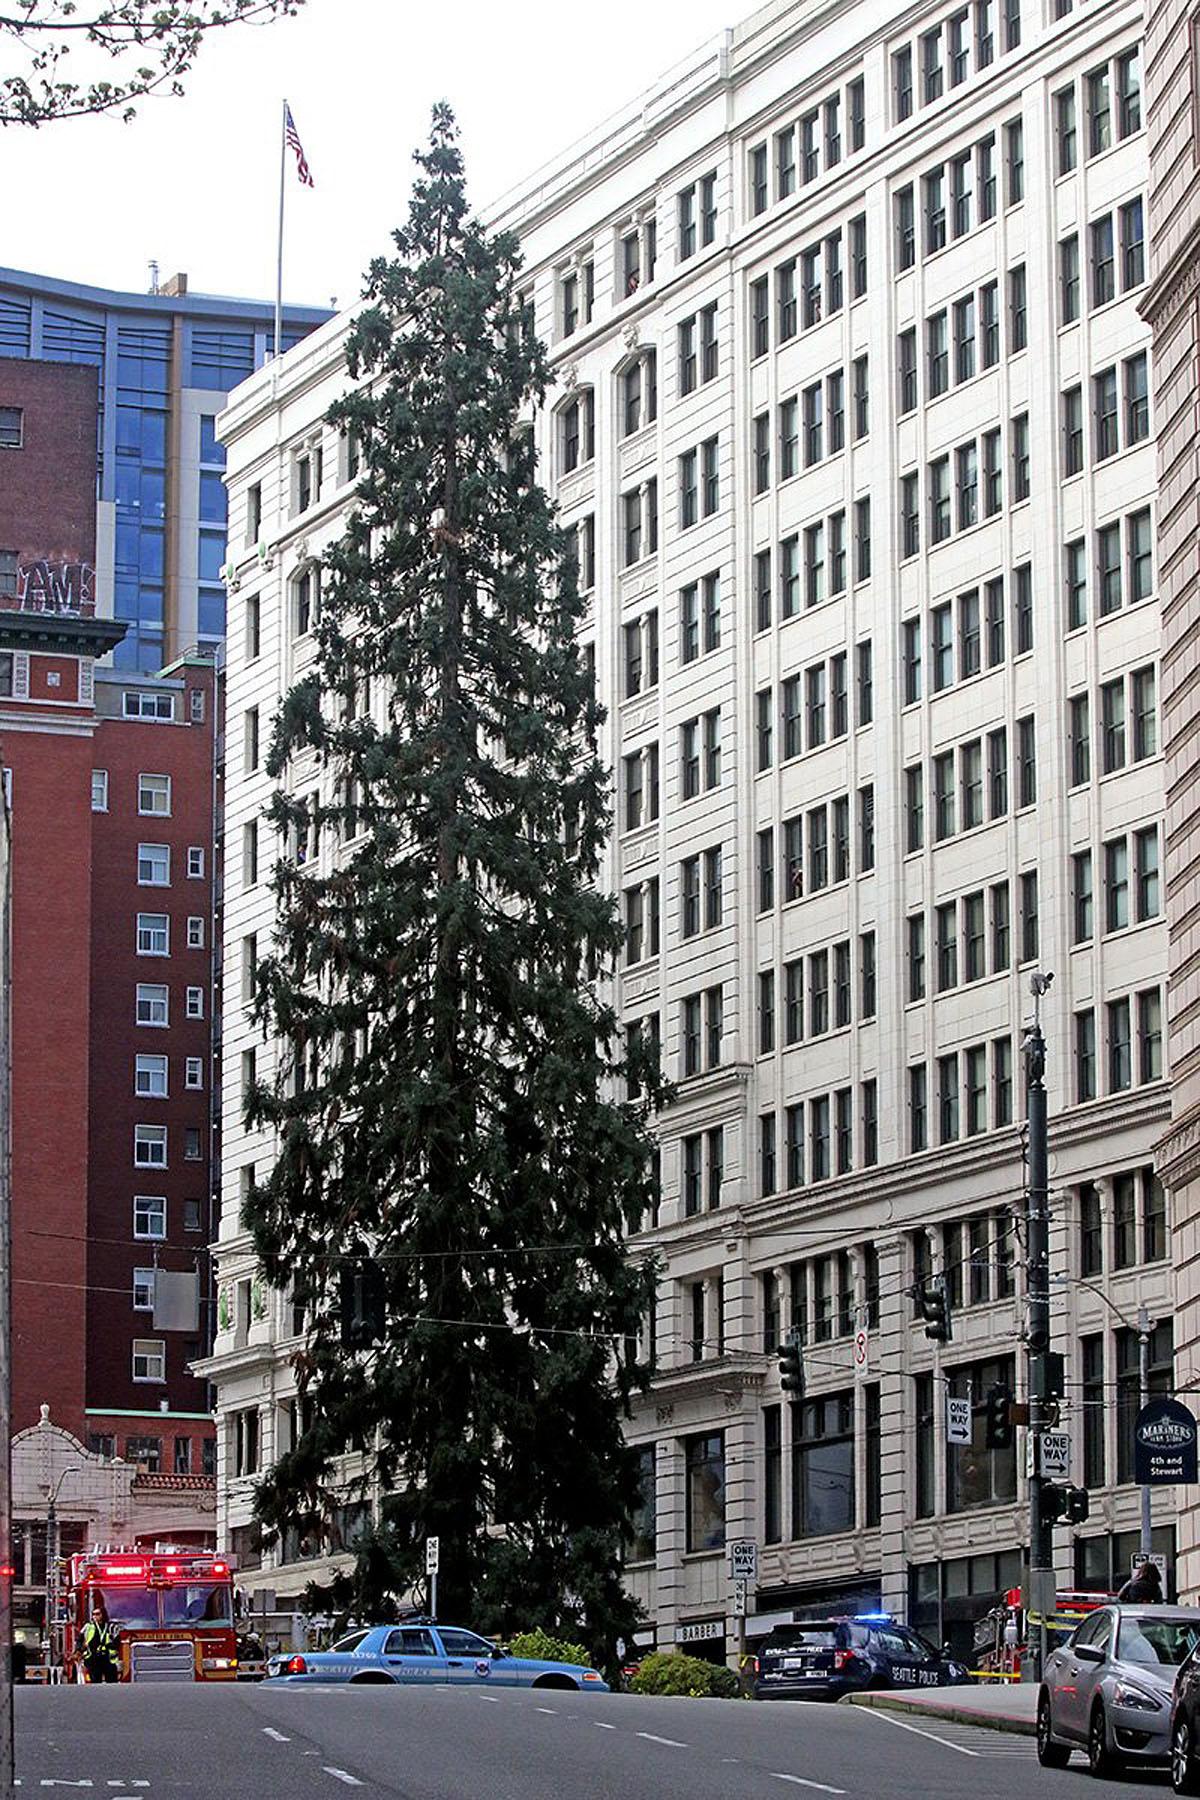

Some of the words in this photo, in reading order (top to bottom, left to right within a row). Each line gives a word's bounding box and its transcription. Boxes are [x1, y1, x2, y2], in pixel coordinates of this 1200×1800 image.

[950, 1402, 968, 1414] ONE
[950, 1415, 968, 1425] WAY
[1142, 1425, 1191, 1439] MARINERS
[1044, 1437, 1066, 1448] ONE
[1043, 1449, 1067, 1460] WAY
[1150, 1456, 1164, 1465] 4th
[1166, 1456, 1183, 1465] and
[1150, 1467, 1183, 1475] Stewart
[734, 1546, 754, 1555] ONE
[734, 1556, 754, 1564] WAY
[682, 1624, 717, 1640] BARBER
[892, 1666, 916, 1683] SEATTLE
[919, 1669, 938, 1685] POLICE
